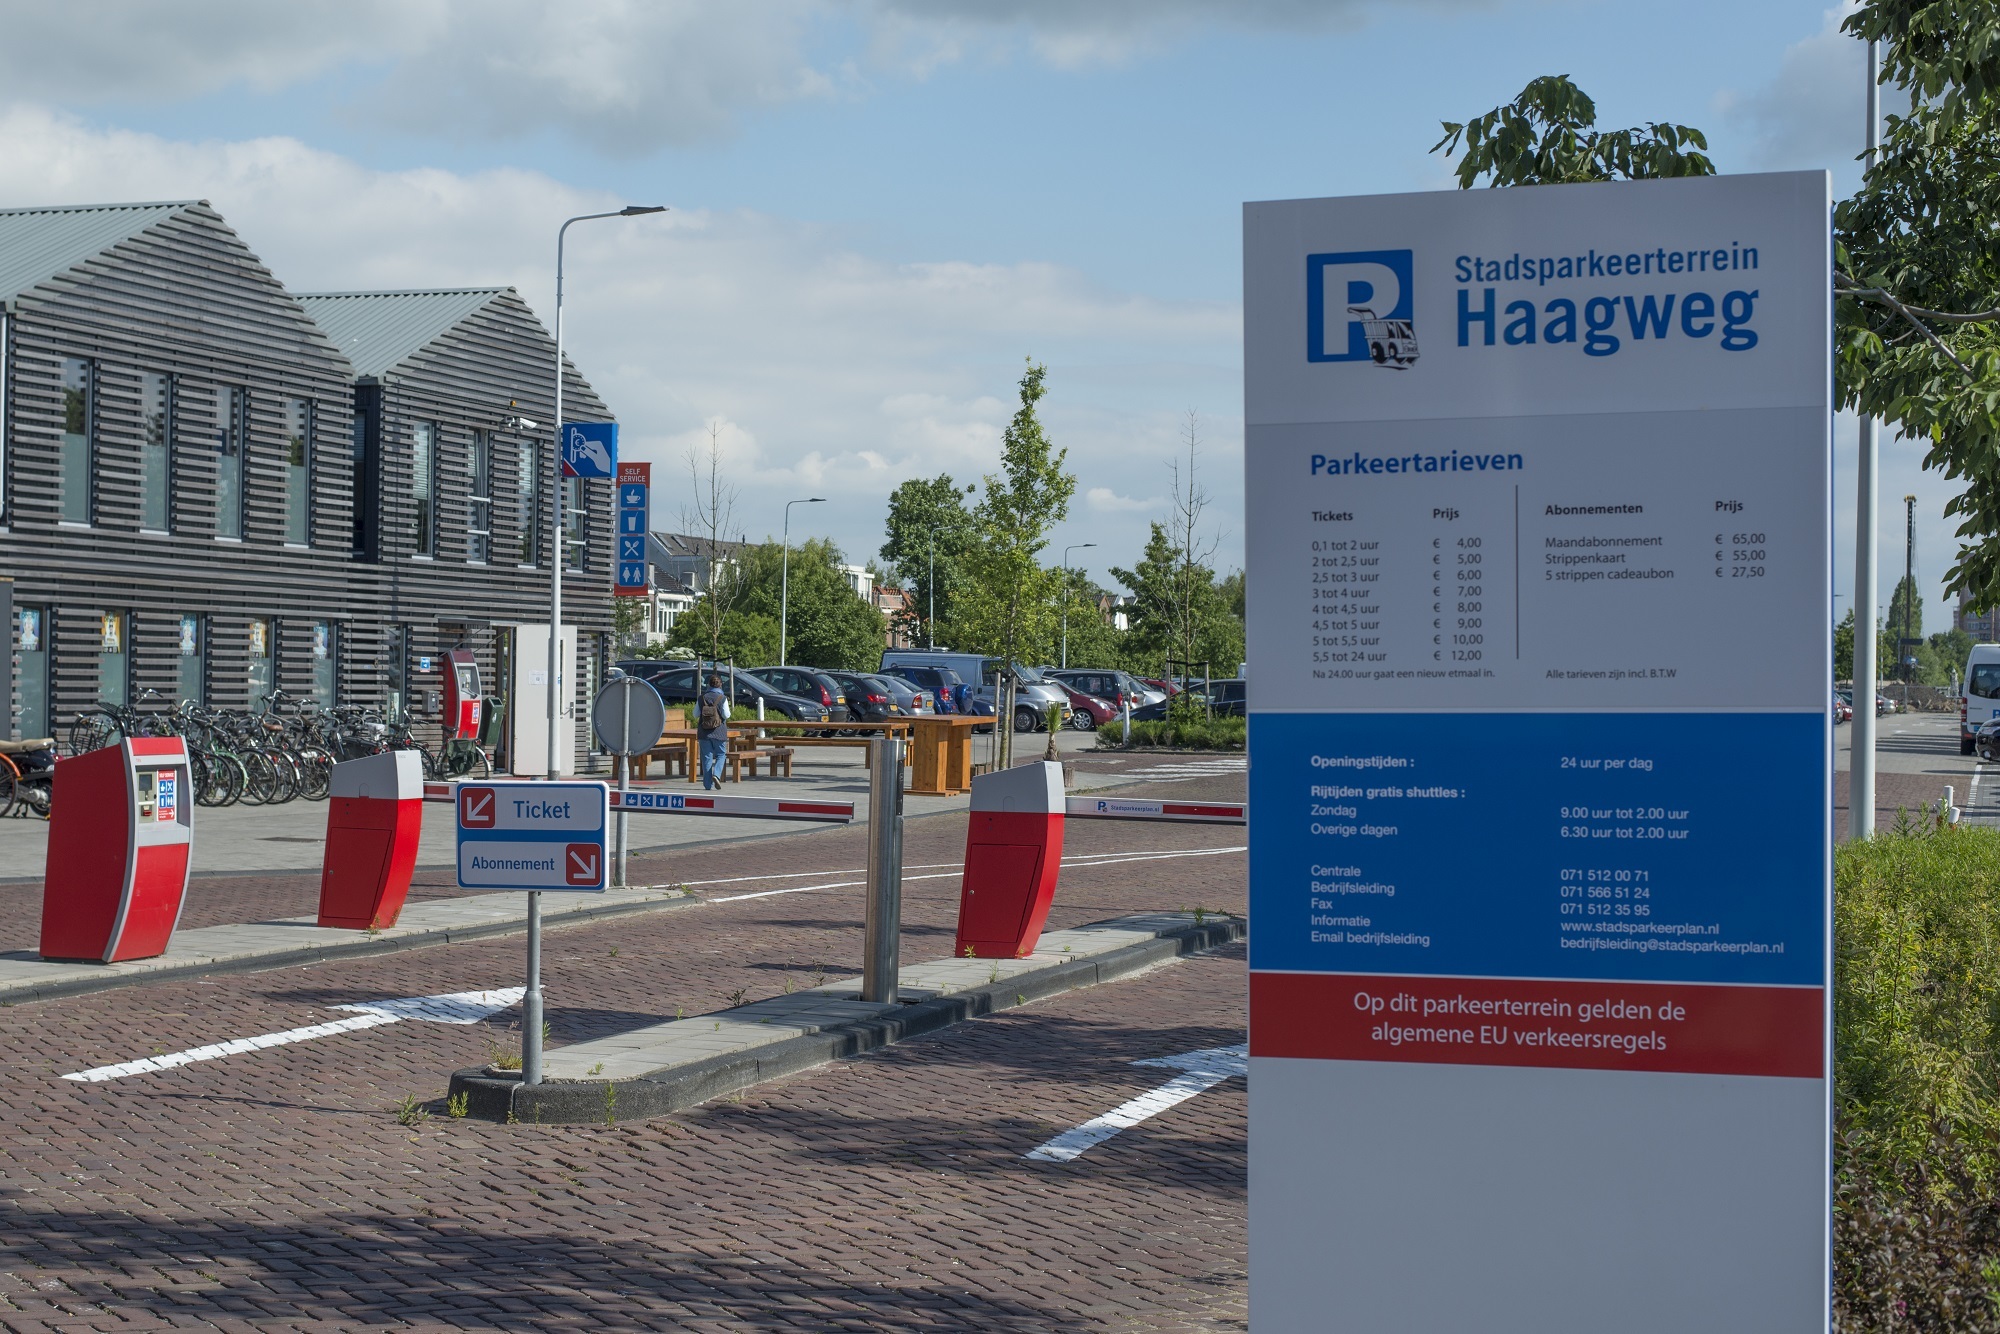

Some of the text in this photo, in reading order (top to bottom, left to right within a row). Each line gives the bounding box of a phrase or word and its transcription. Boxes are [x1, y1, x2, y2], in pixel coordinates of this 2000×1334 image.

[1454, 241, 1758, 286] Stadsparkeerterrein
[1457, 288, 1759, 356] Haagweg
[1311, 450, 1523, 475] Parkeertarieven
[1545, 505, 1643, 515] Abonnementen
[1715, 500, 1743, 513] Prijs
[1312, 511, 1353, 521] Tickets
[1433, 508, 1460, 520] Prijs
[1433, 538, 1482, 550] € 4,00
[1545, 536, 1663, 548] Maandabonnement
[1715, 533, 1765, 546] € 65,00
[1312, 541, 1379, 552] 0,1 tot 2 uur
[1312, 556, 1379, 568] 2 tot 2,5 uur
[1433, 554, 1482, 566] € 5,00
[1545, 553, 1625, 566] Strippenkaart
[1715, 550, 1765, 562] € 55,00
[1312, 573, 1380, 584] 2,5 tot 3 uur
[1433, 570, 1482, 582] € 6,00
[1545, 568, 1674, 582] 5 strippen cadeaubon
[1715, 567, 1765, 579] € 27,50
[1313, 588, 1370, 599] 3 tot 4 uur
[1433, 586, 1482, 598] € 7,00
[1312, 604, 1380, 615] 4 tot 4,5 uur
[1433, 602, 1482, 614] € 8,00
[1312, 620, 1380, 631] 4,5 tot 5 uur
[1433, 618, 1482, 630] € 9,00
[1313, 636, 1380, 647] 5 tot 5,5 uur
[1433, 634, 1483, 646] € 10,00
[1313, 652, 1387, 663] 5,5 tot 24 uur
[1434, 650, 1482, 662] € 12,00
[1313, 669, 1495, 680] Na 24.00 uur gaat een nieuw etmaal in.
[1546, 669, 1676, 680] Alle tarieven zijn incl. B.T.W
[1311, 755, 1407, 769] Openingstijden
[1560, 757, 1653, 771] 24 uur per dag
[1311, 785, 1363, 799] Rijtijden
[1366, 786, 1403, 800] gratis
[1406, 786, 1458, 798] shuttles
[513, 800, 570, 819] Ticket
[1311, 804, 1357, 818] Zondag
[1560, 807, 1689, 819] 9.00 uur tot 2.00 uur
[1311, 823, 1398, 838] Overige dagen
[1560, 826, 1689, 839] 6.30 uur tot 2.00 uur
[471, 856, 555, 871] Abonnement
[1311, 865, 1361, 877] Centrale
[1560, 869, 1649, 881] 071 512 00 71
[1311, 881, 1395, 896] Bedrijfsleiding
[1560, 886, 1650, 898] 071 566 51 24
[1311, 898, 1333, 909] Fax
[1560, 903, 1650, 916] 071 512 35 95
[1311, 914, 1371, 927] Informatie
[1560, 921, 1719, 936] www.stadsparkeerplan.nl
[1311, 931, 1430, 947] Email bedrijfsleiding
[1560, 938, 1784, 955] bedrijfsleiding@stadsparkeerplan.nl
[1354, 992, 1686, 1022] Op dit parkeerterrein gelden de
[1371, 1022, 1666, 1054] algemene EU verkeersregels
